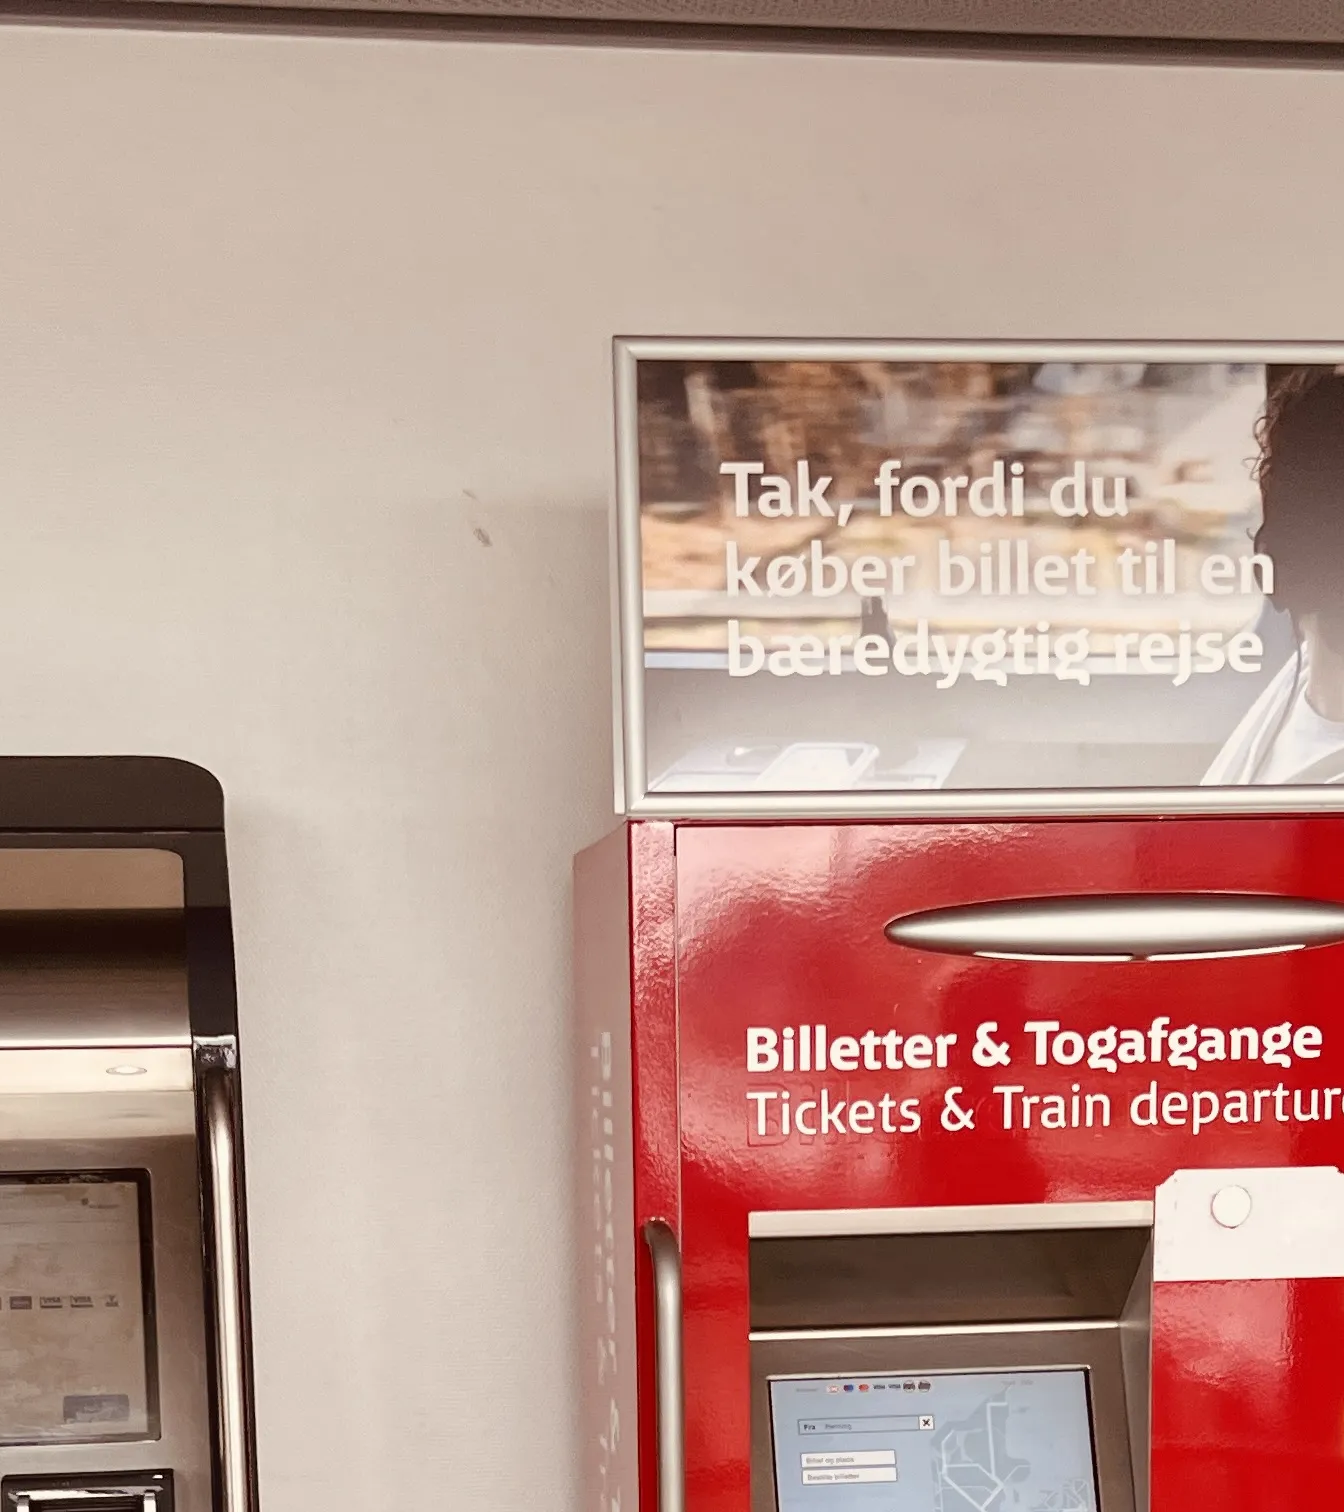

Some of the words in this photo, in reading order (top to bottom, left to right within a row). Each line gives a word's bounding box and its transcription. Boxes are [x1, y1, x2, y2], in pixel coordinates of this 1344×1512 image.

[719, 459, 854, 527] Tak,
[874, 458, 1026, 519] fordi
[1049, 459, 1129, 518] du
[725, 541, 916, 600] køber
[938, 540, 1098, 599] billet
[1116, 540, 1178, 597] til
[1198, 553, 1276, 596] en
[727, 619, 1092, 689] bæredygtig
[1110, 621, 1265, 688] rejse
[746, 1024, 957, 1073] Billetter
[971, 1021, 1012, 1067] &
[1023, 1016, 1323, 1074] Togafgange
[748, 1082, 921, 1136] Tickets
[940, 1086, 975, 1131] &
[993, 1083, 1111, 1130] Train
